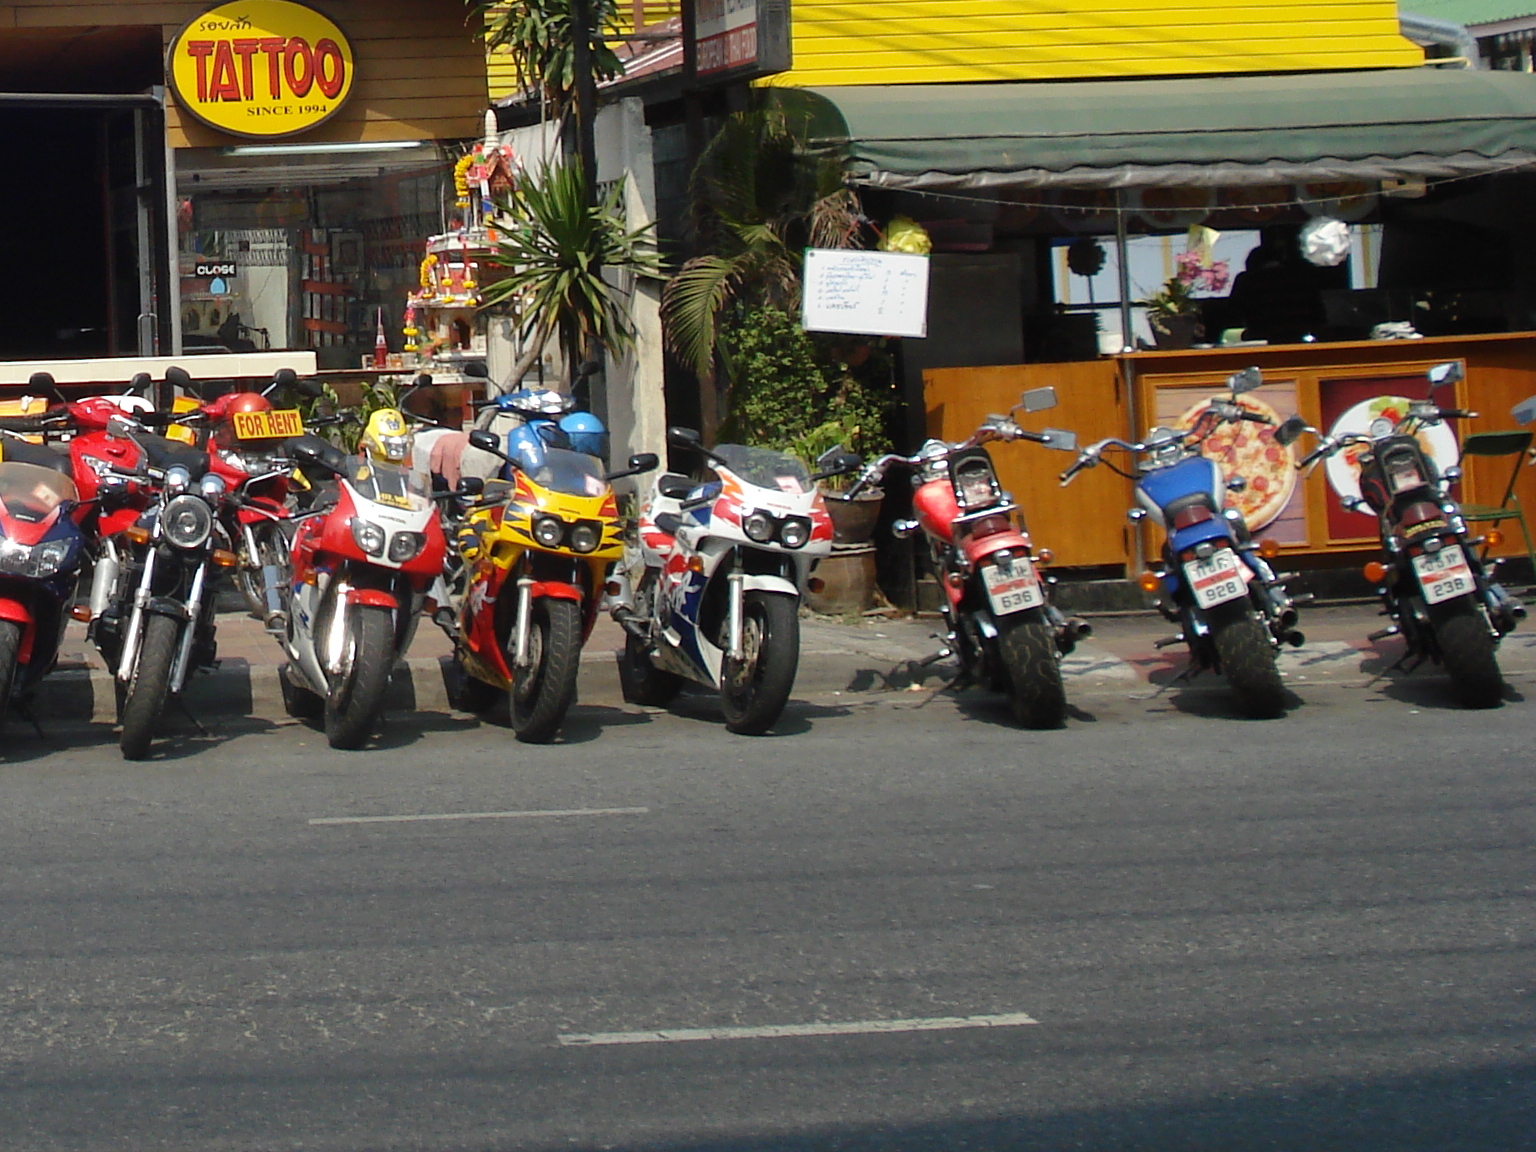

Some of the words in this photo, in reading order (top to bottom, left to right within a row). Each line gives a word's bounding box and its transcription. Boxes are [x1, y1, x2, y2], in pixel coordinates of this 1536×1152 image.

[199, 14, 252, 32] รอยสัก
[187, 36, 345, 103] TATTOO
[247, 105, 293, 116] SINCE
[298, 105, 327, 116] 1994
[197, 264, 235, 275] CLOSE
[238, 414, 264, 436] FOR
[267, 412, 299, 435] RENT
[1206, 581, 1237, 601] 928
[1433, 578, 1464, 597] 238
[1001, 590, 1032, 608] 636
